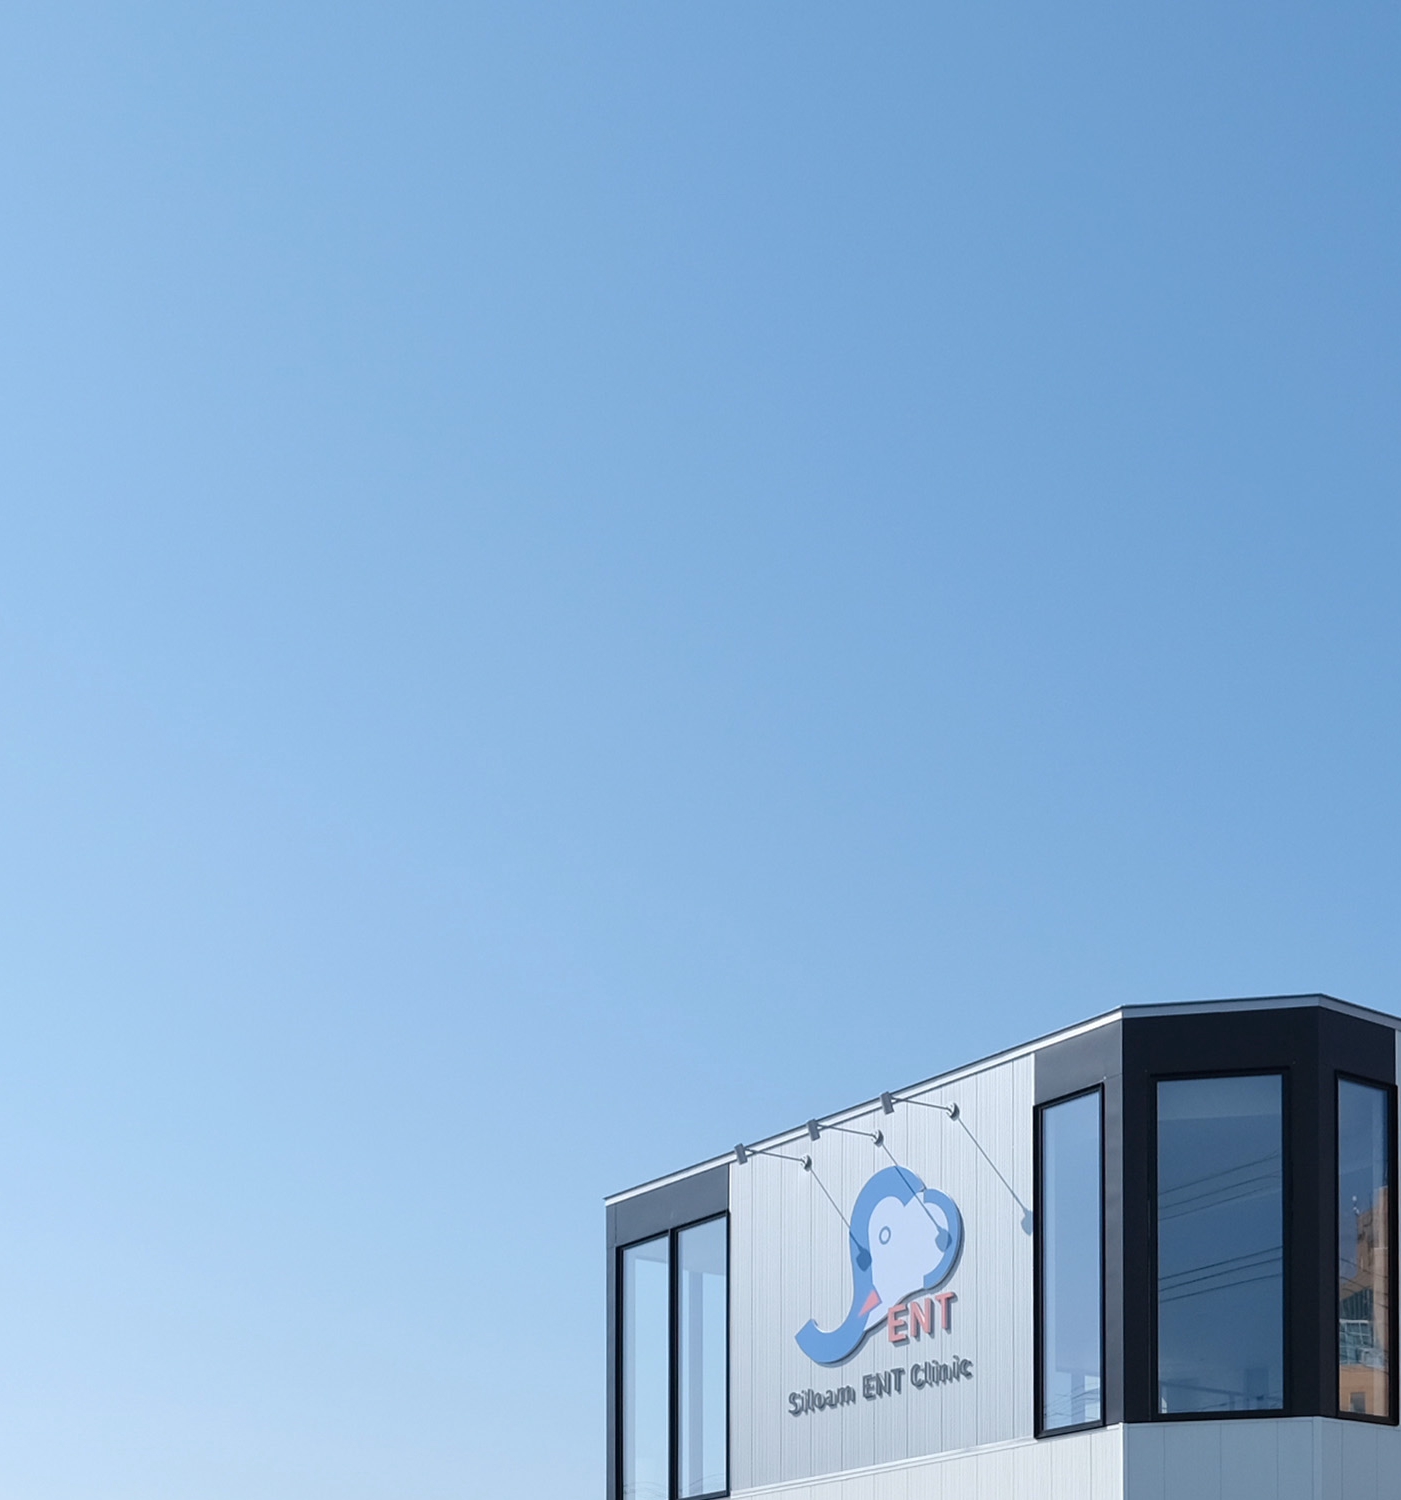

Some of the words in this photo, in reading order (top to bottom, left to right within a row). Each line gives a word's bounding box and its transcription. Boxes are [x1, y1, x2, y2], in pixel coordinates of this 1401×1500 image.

[887, 1291, 956, 1344] ENT
[788, 1386, 856, 1415] Siloam
[862, 1367, 906, 1400] ENT
[910, 1355, 973, 1387] Clinic
